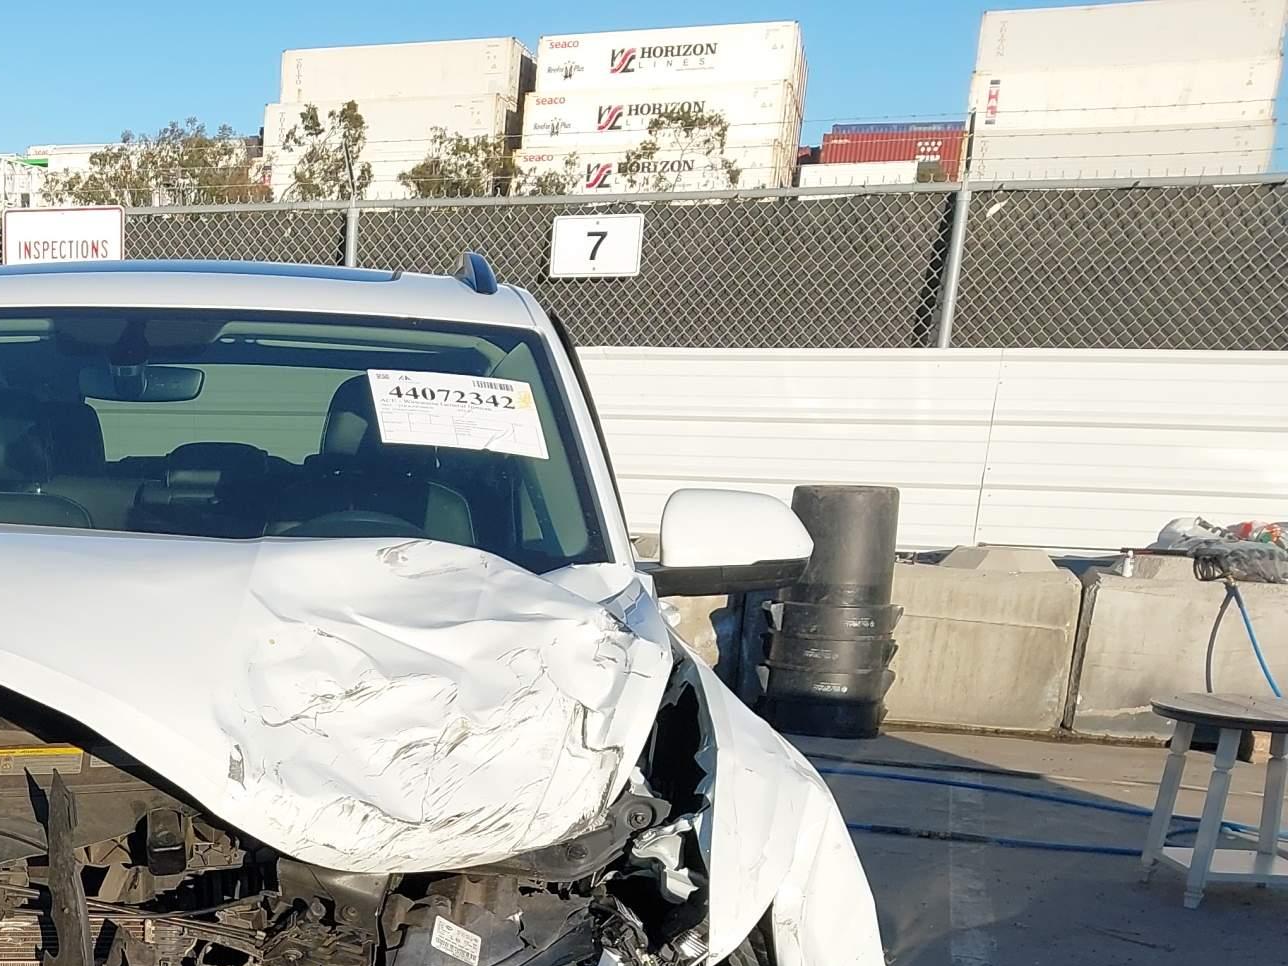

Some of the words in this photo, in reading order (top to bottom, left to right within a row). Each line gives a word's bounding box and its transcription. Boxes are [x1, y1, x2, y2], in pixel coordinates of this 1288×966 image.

[549, 40, 579, 49] seaco
[639, 43, 718, 59] HORIZON
[638, 58, 705, 69] LINES
[535, 97, 566, 106] seaco
[627, 100, 706, 116] HORIZON
[523, 154, 554, 162] seaco
[18, 239, 109, 260] INSPECTIONS
[586, 231, 608, 261] 7
[388, 385, 516, 410] 44072342
